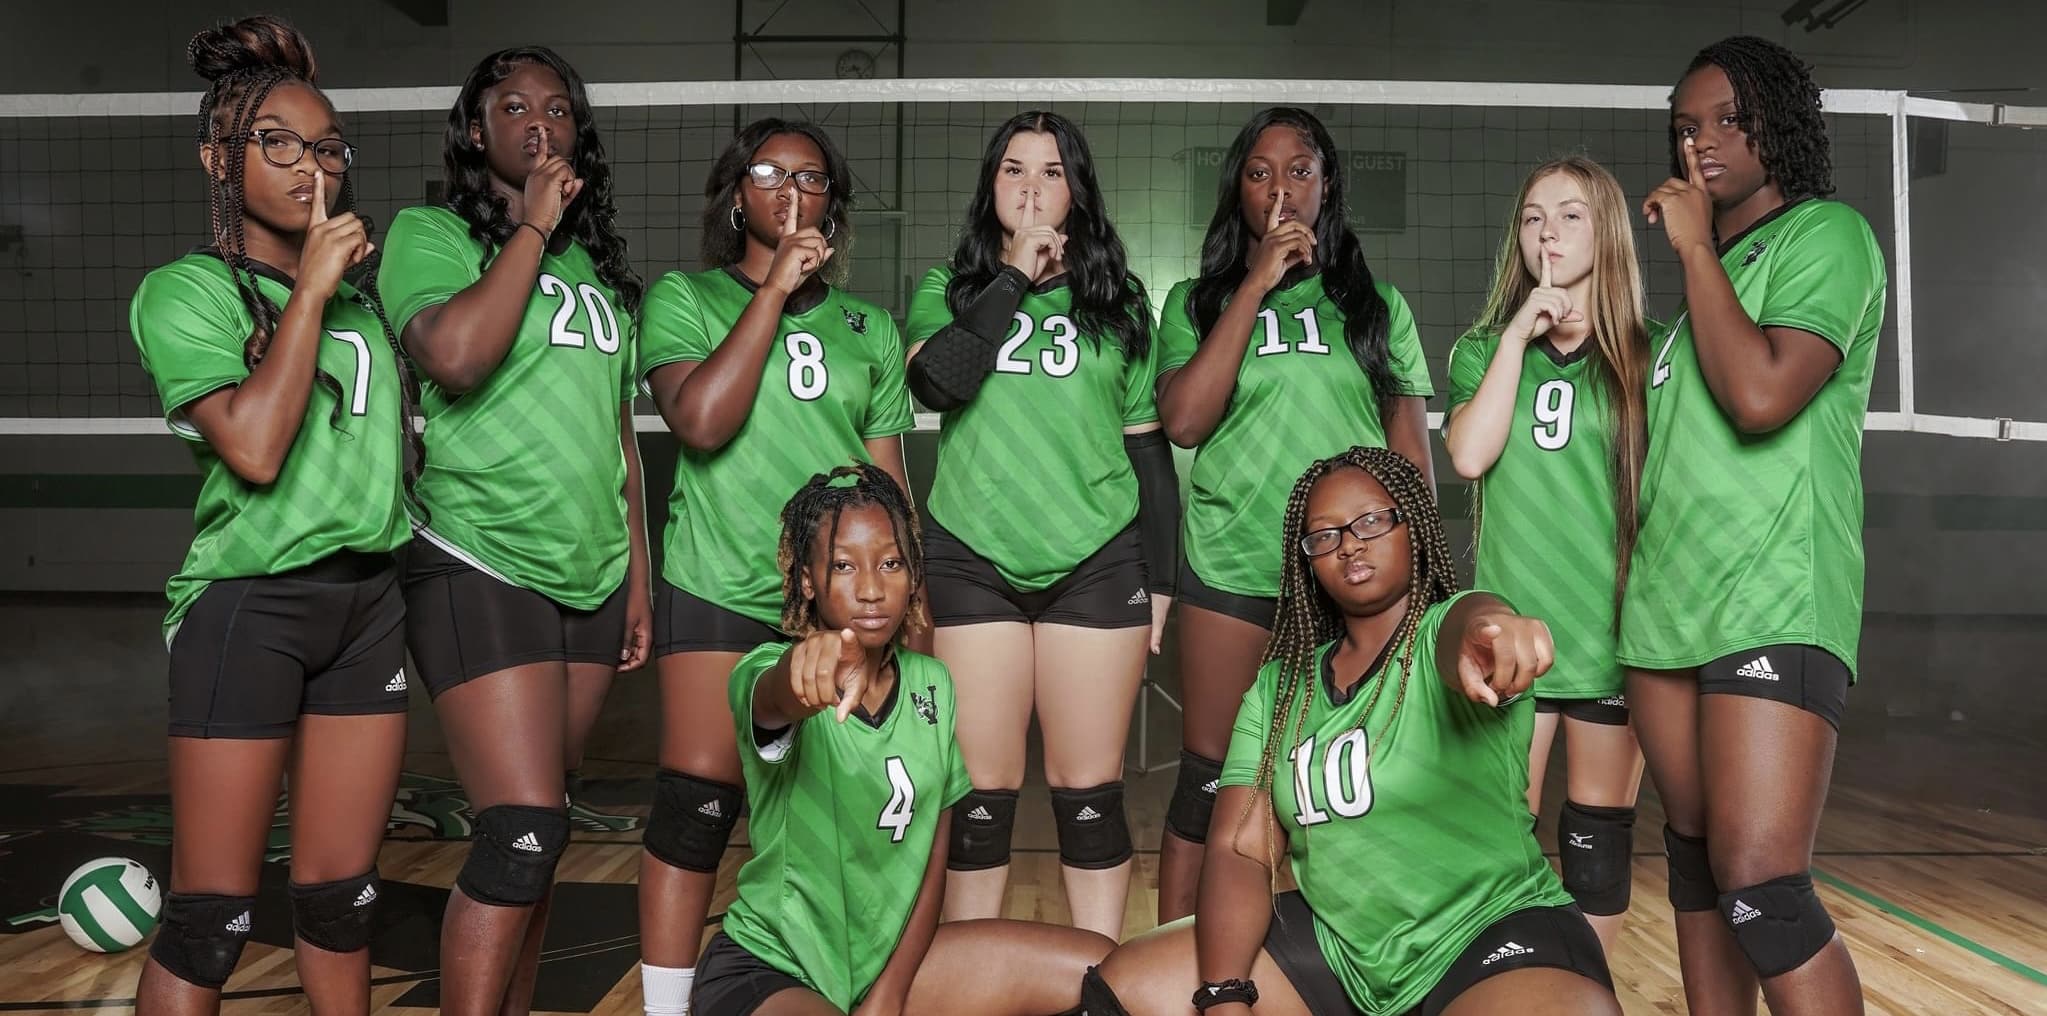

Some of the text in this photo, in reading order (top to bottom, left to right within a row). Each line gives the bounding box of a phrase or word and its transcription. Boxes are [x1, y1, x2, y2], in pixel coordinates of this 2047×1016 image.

[1353, 154, 1404, 171] GUEST
[538, 272, 620, 355] 20
[995, 310, 1079, 378] 23
[1256, 307, 1330, 357] 11
[323, 327, 372, 416] 7
[784, 330, 828, 401] 8
[1532, 378, 1575, 451] 9
[1737, 668, 1779, 681] adidas
[876, 755, 915, 843] 4
[1287, 726, 1374, 827] 10
[512, 842, 542, 852] adidas
[1732, 908, 1762, 925] adidas
[1482, 947, 1534, 965] adidas
